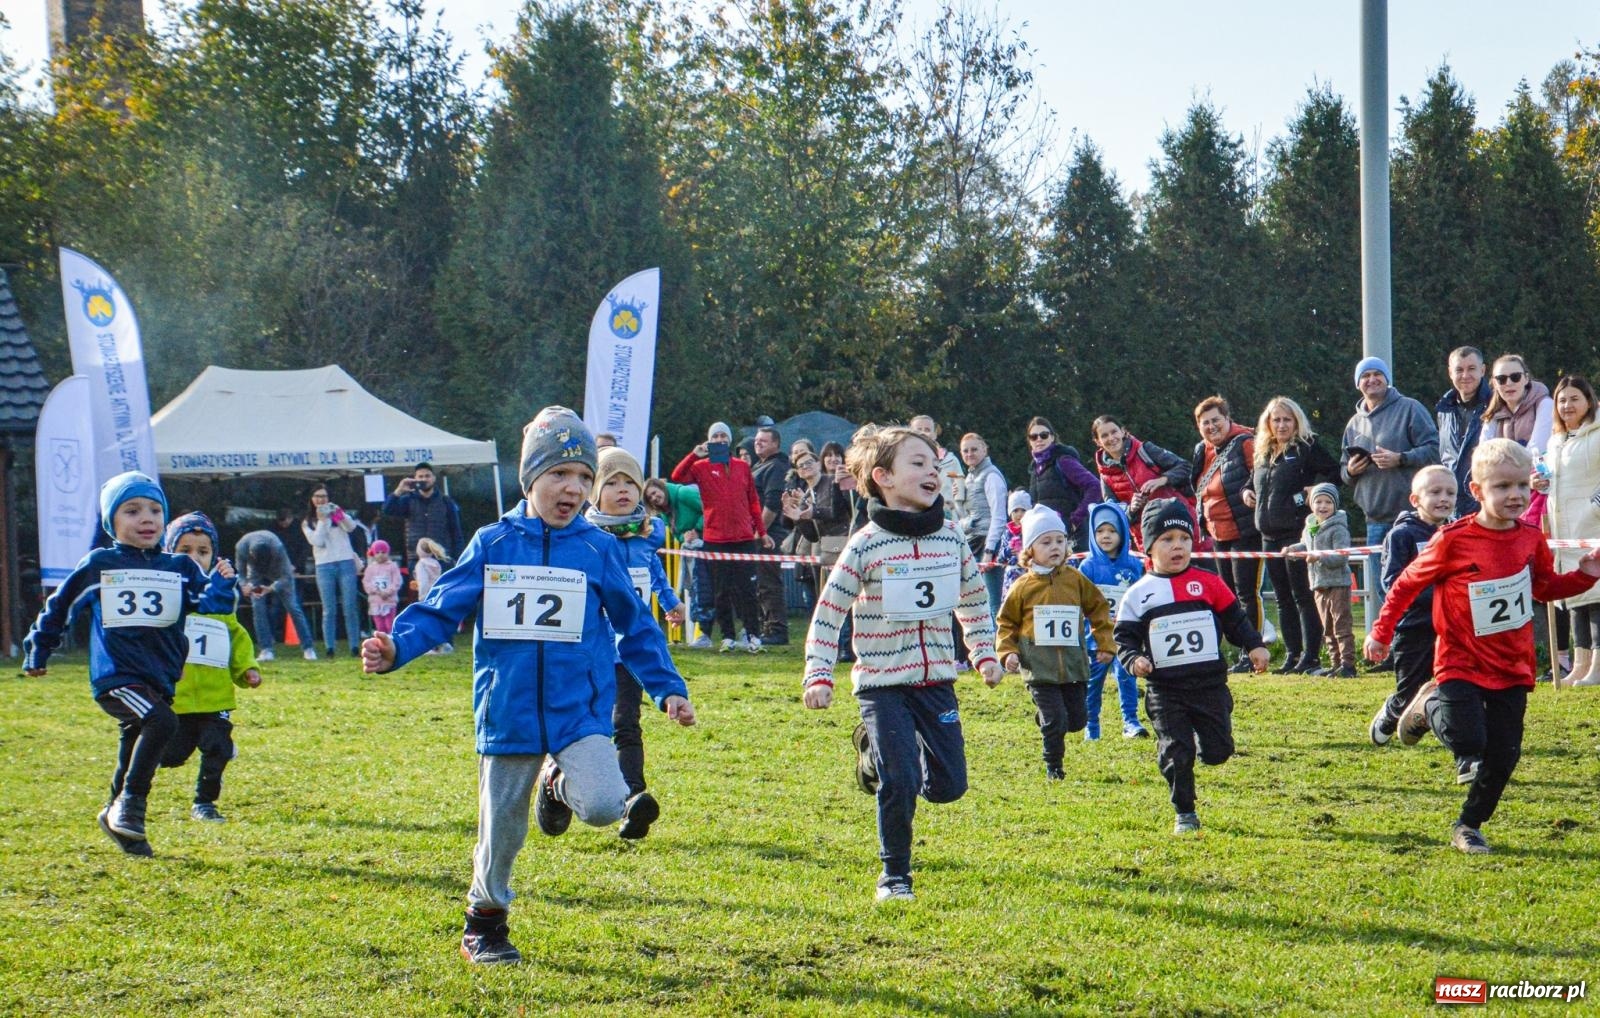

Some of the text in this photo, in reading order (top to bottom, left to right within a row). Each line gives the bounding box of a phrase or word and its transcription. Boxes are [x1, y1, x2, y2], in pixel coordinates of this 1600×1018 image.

[610, 344, 633, 402] STOWARZYSZENIE
[171, 449, 433, 469] STOWARZYSZENIE AKTYWNI DLA LEPSZEGO JUTRA
[1163, 519, 1189, 530] JUNIOR
[117, 590, 163, 616] 33
[915, 581, 936, 608] 3
[1489, 592, 1525, 623] 21
[507, 592, 563, 627] 12
[1045, 620, 1072, 638] 16
[195, 634, 208, 655] 1
[1165, 630, 1204, 657] 29
